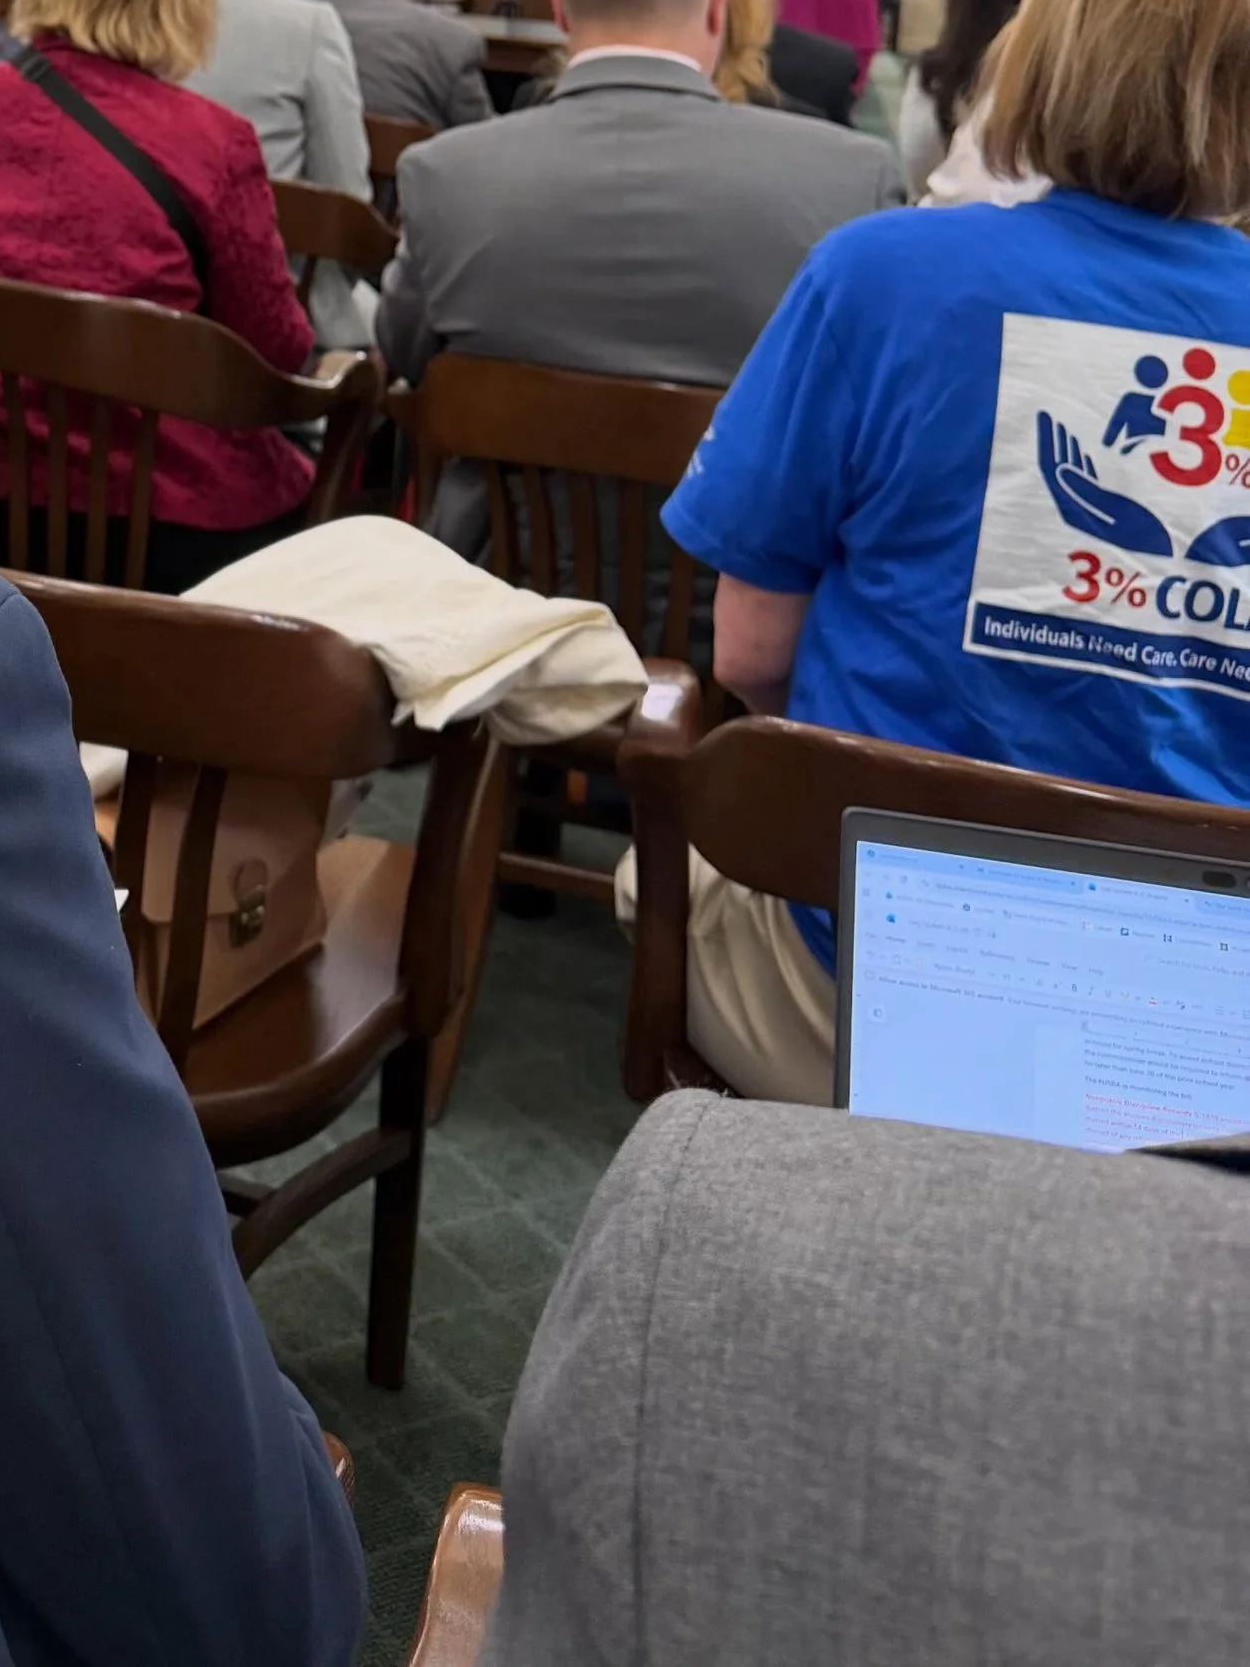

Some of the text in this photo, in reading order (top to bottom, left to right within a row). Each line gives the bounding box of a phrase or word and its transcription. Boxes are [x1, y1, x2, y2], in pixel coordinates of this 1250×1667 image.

[1062, 549, 1250, 631] 3% COL
[984, 616, 1085, 651] Individuals
[1088, 636, 1138, 663] Need
